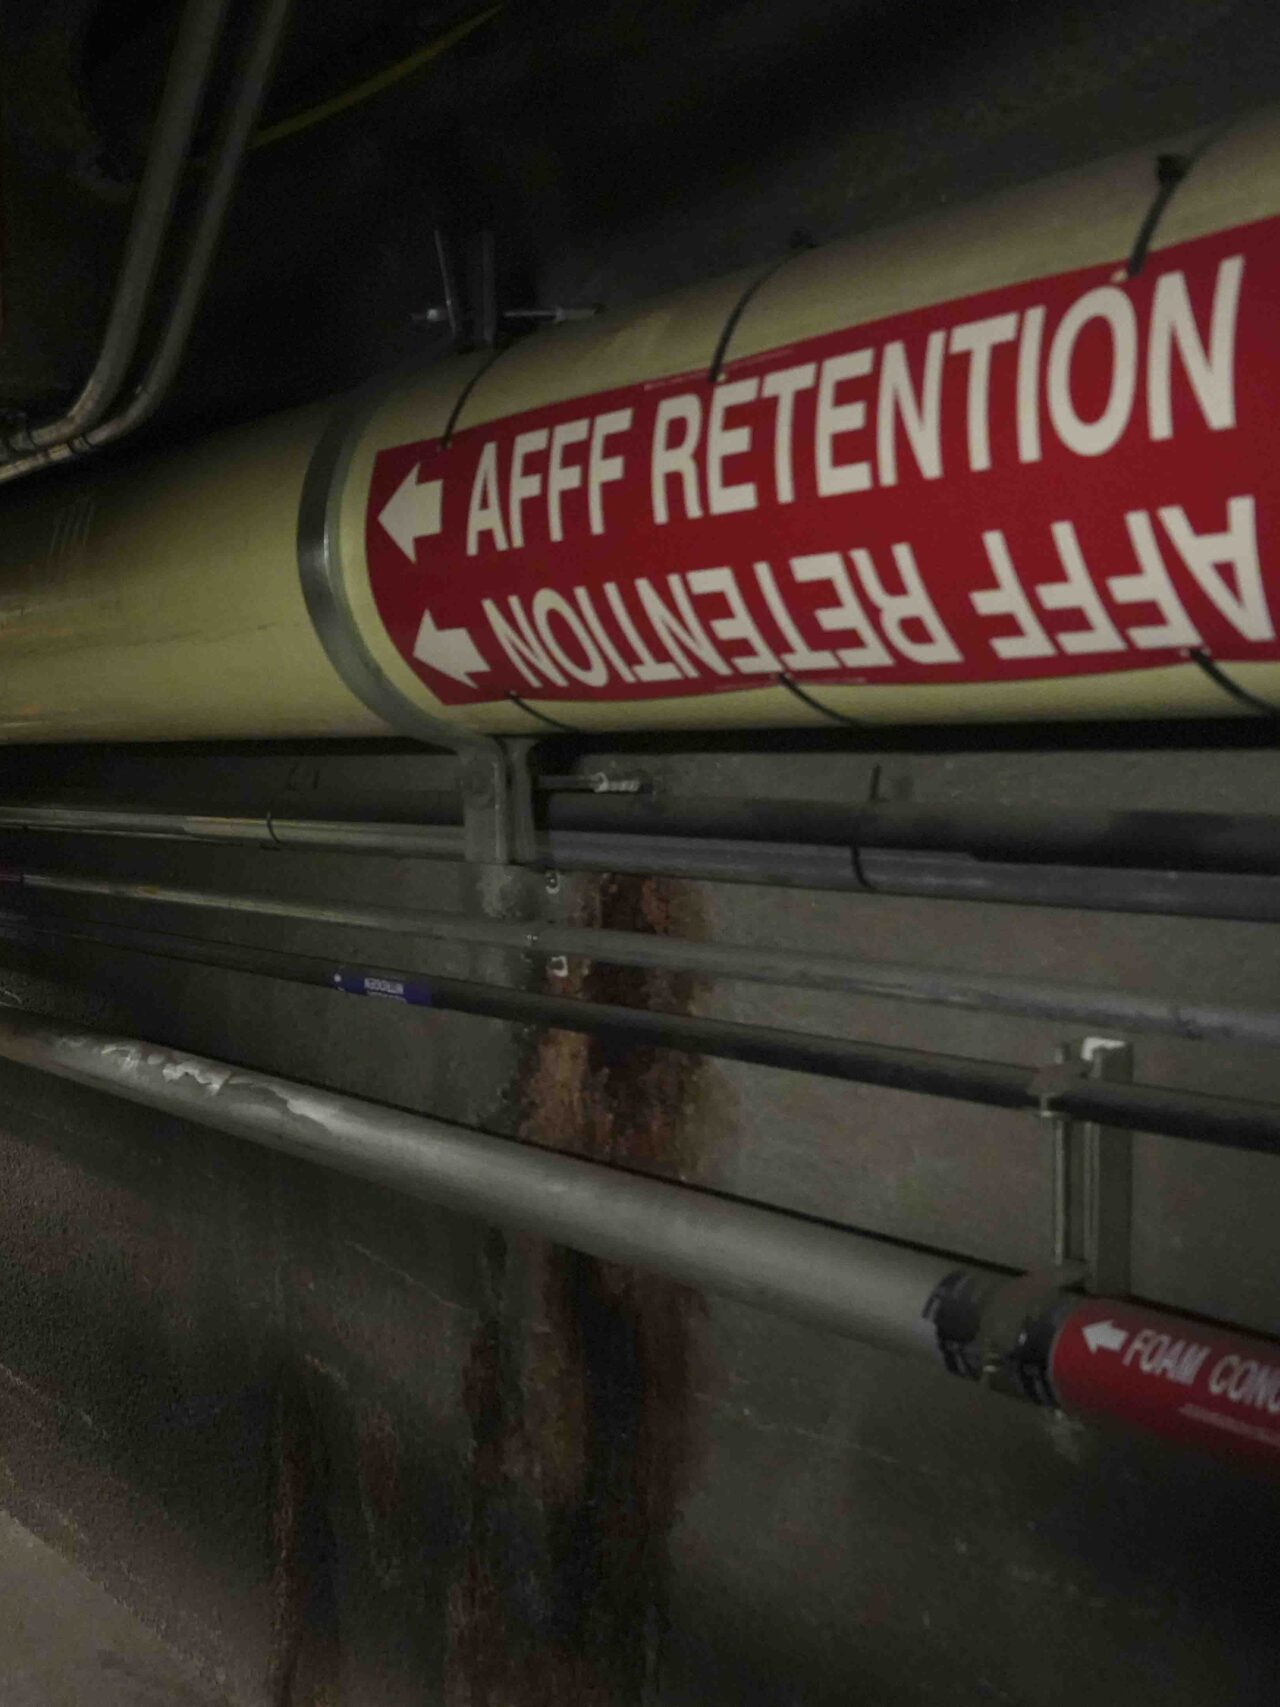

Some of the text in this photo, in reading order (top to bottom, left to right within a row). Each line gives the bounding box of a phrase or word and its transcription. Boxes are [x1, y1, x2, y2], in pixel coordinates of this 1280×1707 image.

[465, 256, 1244, 555] AFFF RETENTION
[482, 494, 1277, 690] AFFF RETENTION
[1122, 1328, 1213, 1386] FOAM
